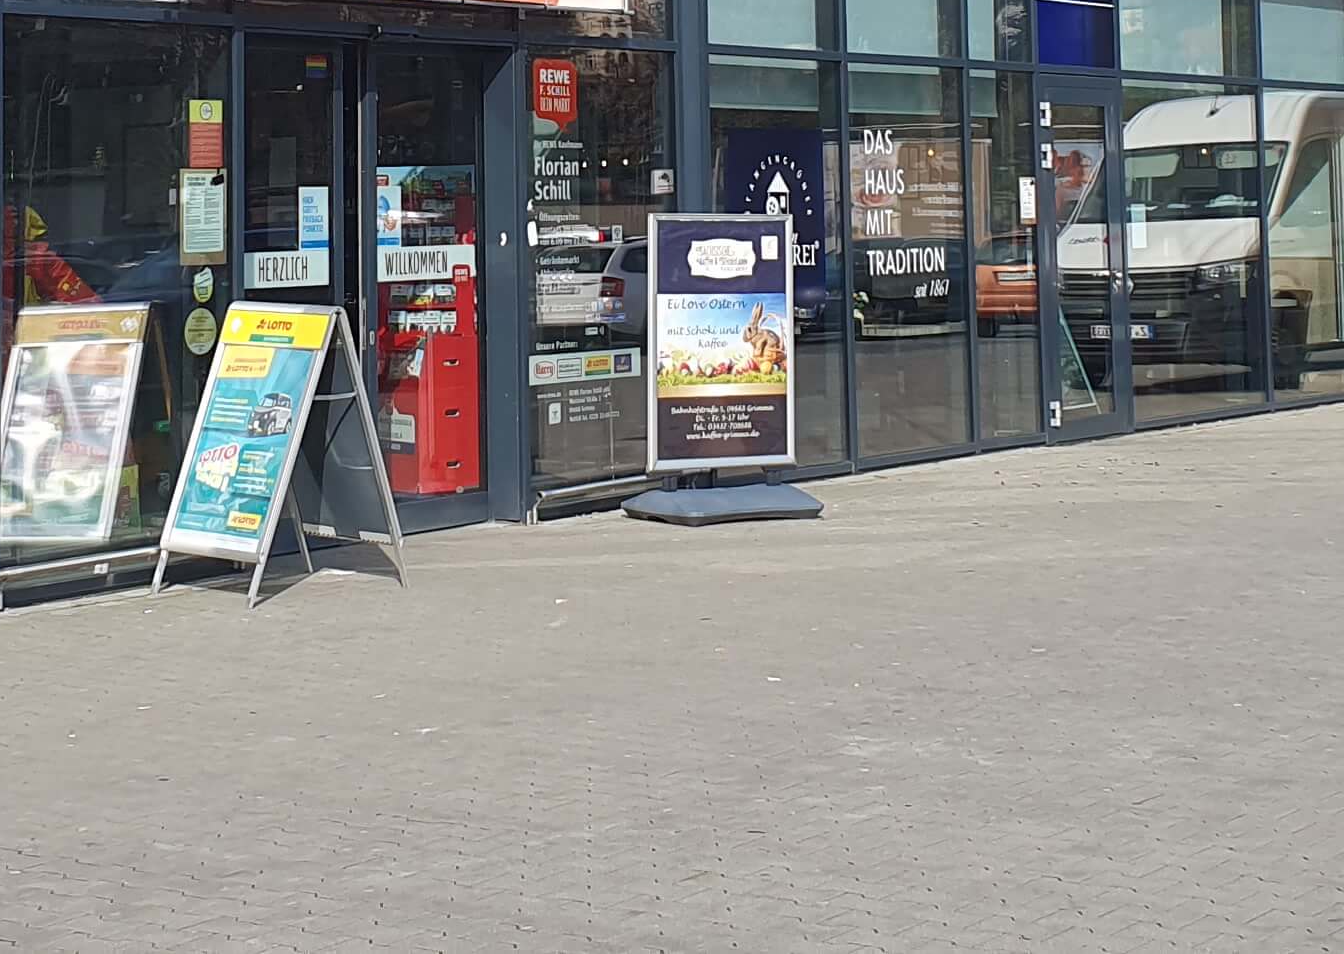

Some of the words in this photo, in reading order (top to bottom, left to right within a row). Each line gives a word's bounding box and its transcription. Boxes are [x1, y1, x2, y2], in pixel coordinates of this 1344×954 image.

[539, 68, 571, 85] REWE
[547, 85, 571, 96] SCHILL
[863, 129, 894, 155] DAS
[534, 155, 579, 177] Florian
[534, 179, 572, 201] Schill
[864, 168, 905, 195] HAUS
[865, 209, 894, 236] MIT
[257, 254, 308, 282] HERZLICH
[384, 250, 448, 276] WILLKOMMEN
[866, 246, 945, 277] TRADITION
[914, 282, 928, 298] seit
[667, 298, 680, 310] Ei
[681, 298, 707, 310] Love
[709, 298, 747, 310] Ostern
[267, 320, 293, 331] LOTTO
[667, 325, 684, 336] mit
[685, 325, 718, 336] Schoki
[719, 324, 741, 335] und
[536, 364, 555, 376] Harry
